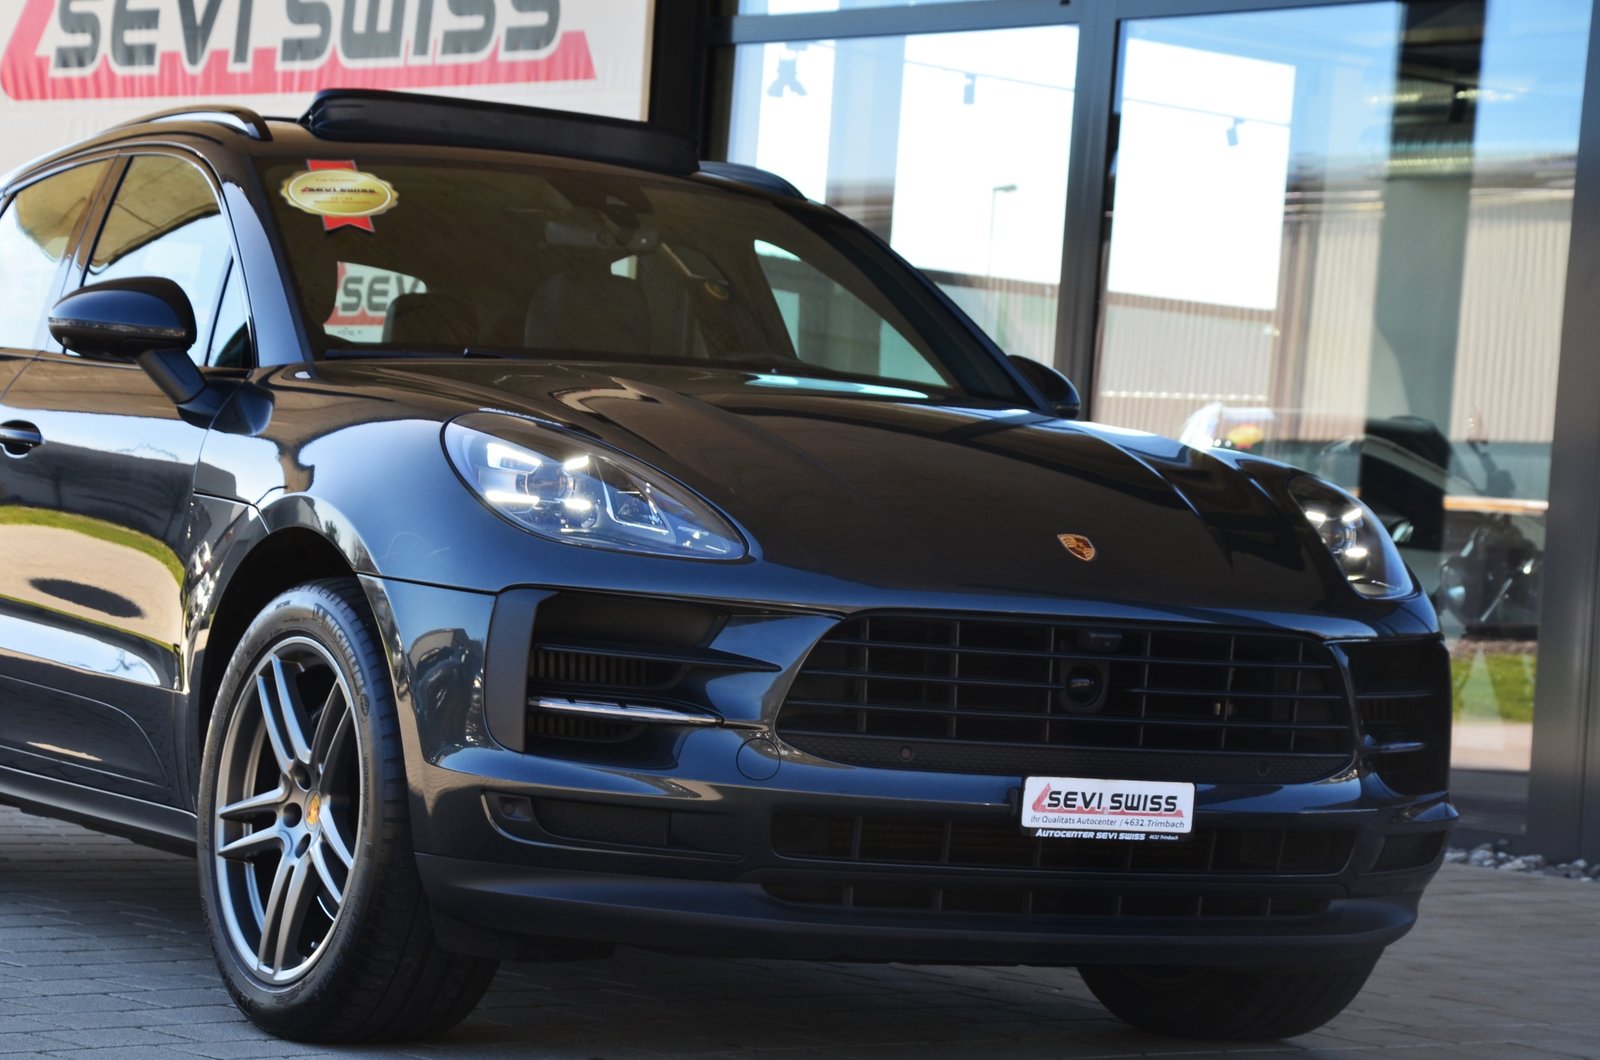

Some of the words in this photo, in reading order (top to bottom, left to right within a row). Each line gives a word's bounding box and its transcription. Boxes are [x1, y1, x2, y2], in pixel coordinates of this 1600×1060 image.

[54, 0, 253, 68] SEVI
[281, 0, 560, 62] SWISS
[1047, 790, 1103, 810] SEVI
[1109, 793, 1178, 812] SWISS
[1076, 817, 1117, 826] Autocenter
[1124, 819, 1144, 827] 4632
[1147, 819, 1185, 829] Trimbach
[1095, 831, 1118, 840] SEVI
